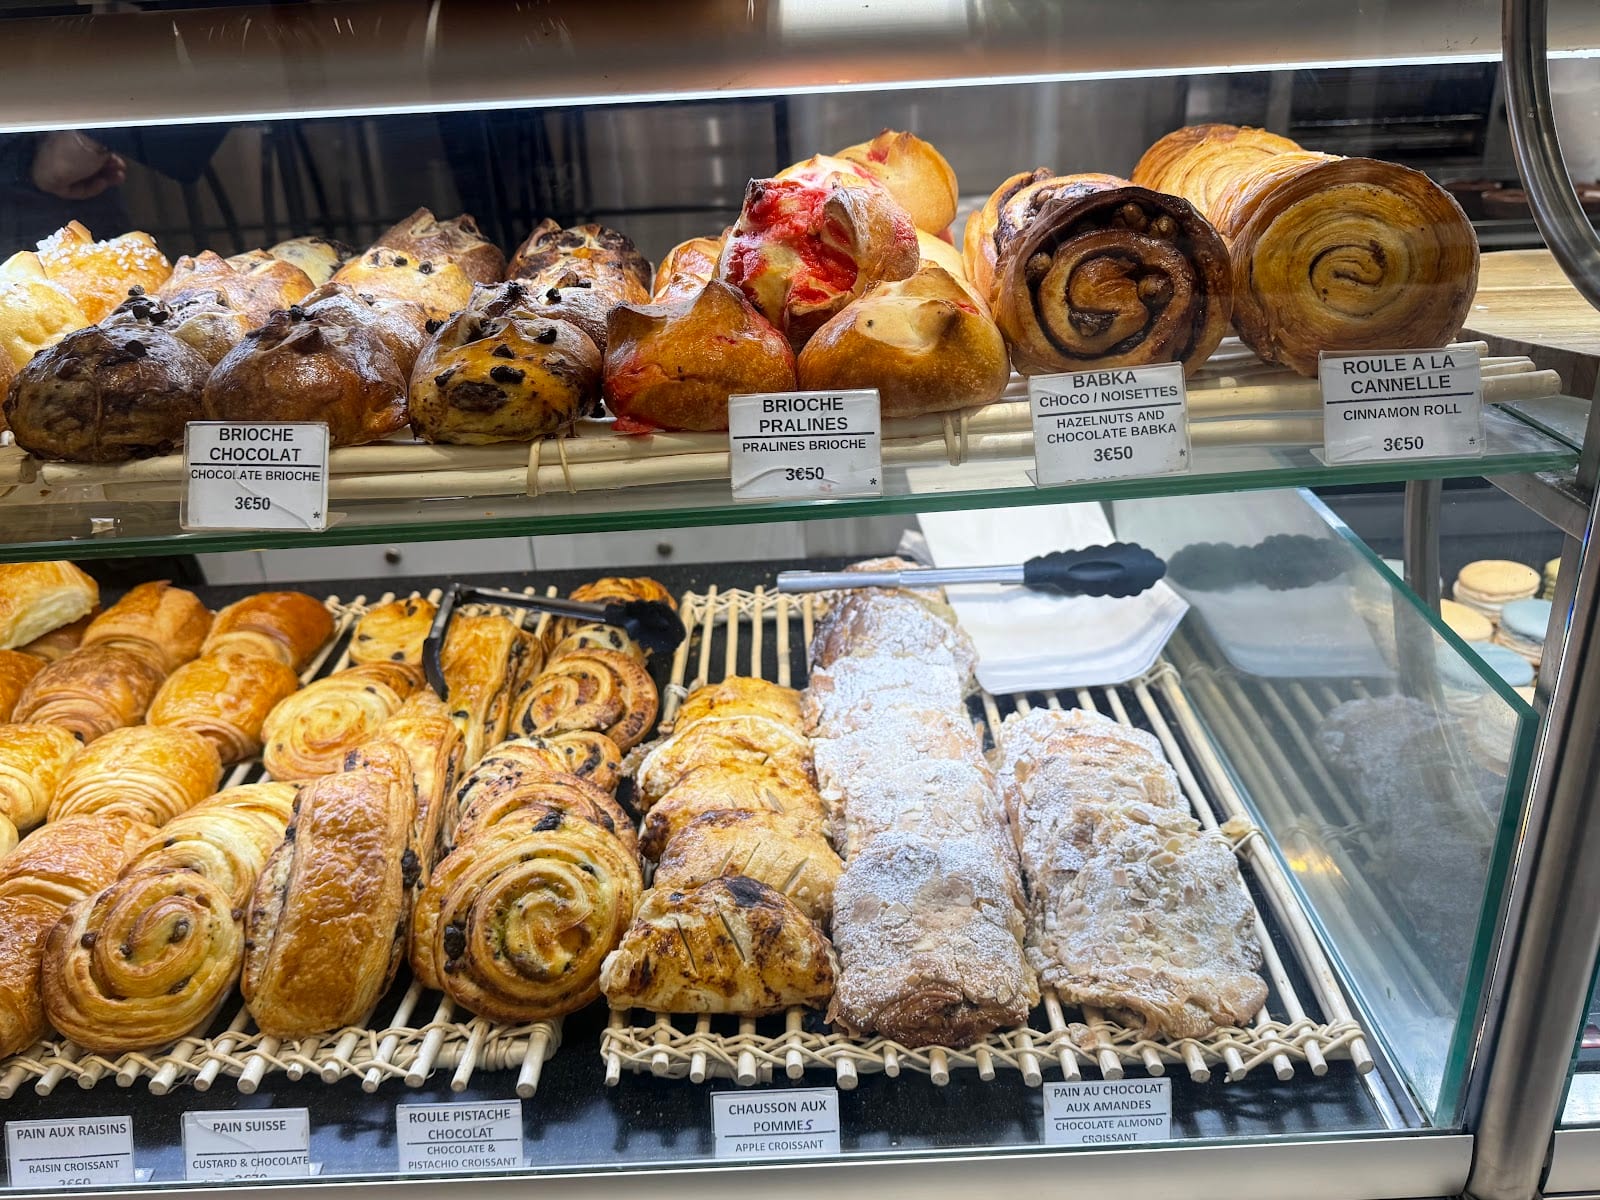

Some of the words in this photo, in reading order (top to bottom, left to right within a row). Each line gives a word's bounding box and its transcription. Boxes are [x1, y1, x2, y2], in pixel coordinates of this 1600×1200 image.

[1343, 358, 1406, 374] ROULE
[1413, 357, 1424, 370] A
[1431, 355, 1455, 368] LA
[1073, 372, 1136, 388] BABKA
[1351, 375, 1451, 394] CANNELLE
[1040, 394, 1089, 407] CHOCO
[1094, 393, 1097, 403] /
[1102, 386, 1177, 402] NOISETTES
[763, 398, 843, 412] BRIOCHE
[1344, 406, 1419, 420] CINNAMON
[1424, 404, 1461, 415] ROLL
[760, 417, 848, 432] PRALINES
[1057, 413, 1133, 428] HAZELNUTS
[1138, 410, 1164, 421] AND
[220, 428, 293, 441] BRIOCHE
[1048, 428, 1127, 443] CHOCOLATE
[1131, 424, 1176, 436] BABKA
[743, 441, 805, 452] PRALINES
[809, 439, 866, 450] BRIOCHE
[1384, 436, 1423, 451] 3€50
[210, 448, 301, 461] CHOCOLAT
[1094, 446, 1133, 462] 3€50
[191, 470, 262, 480] CHOCOLATE
[266, 472, 320, 481] BRIOCHE
[786, 467, 824, 480] 3€50
[235, 497, 270, 510] 3€50
[1054, 1088, 1079, 1098] PAIN
[1084, 1087, 1099, 1096] AU
[1104, 1084, 1163, 1095] CHOCOLAT
[729, 1102, 797, 1115] CHAUSSON
[801, 1100, 827, 1111] AUX
[1067, 1103, 1090, 1112] AUX
[1094, 1100, 1151, 1111] AMANDES
[409, 1112, 449, 1123] ROULE
[454, 1109, 511, 1121] PISTACHE
[213, 1122, 242, 1132] PAIN
[245, 1121, 286, 1131] SUISSE
[754, 1120, 813, 1132] POMMES
[1056, 1120, 1114, 1130] CHOCOLATE
[1118, 1118, 1162, 1127] ALMOND
[17, 1129, 45, 1139] PAIN
[49, 1127, 75, 1137] AUX
[79, 1124, 126, 1136] RAISINS
[428, 1128, 493, 1140] CHOCOLAT
[1082, 1133, 1137, 1143] CROISSANT
[427, 1145, 485, 1154] CHOCOLATE
[488, 1144, 495, 1152] &
[736, 1143, 765, 1152] APPLE
[768, 1140, 823, 1151] CROISSANT
[29, 1164, 61, 1173] RAISIN
[64, 1160, 119, 1171] CROISSANT
[193, 1159, 237, 1168] CUSTARD
[240, 1159, 247, 1167] &
[251, 1156, 309, 1167] CHOCOLATE
[409, 1160, 458, 1169] PISTACHIO
[462, 1158, 516, 1167] CROISSANT
